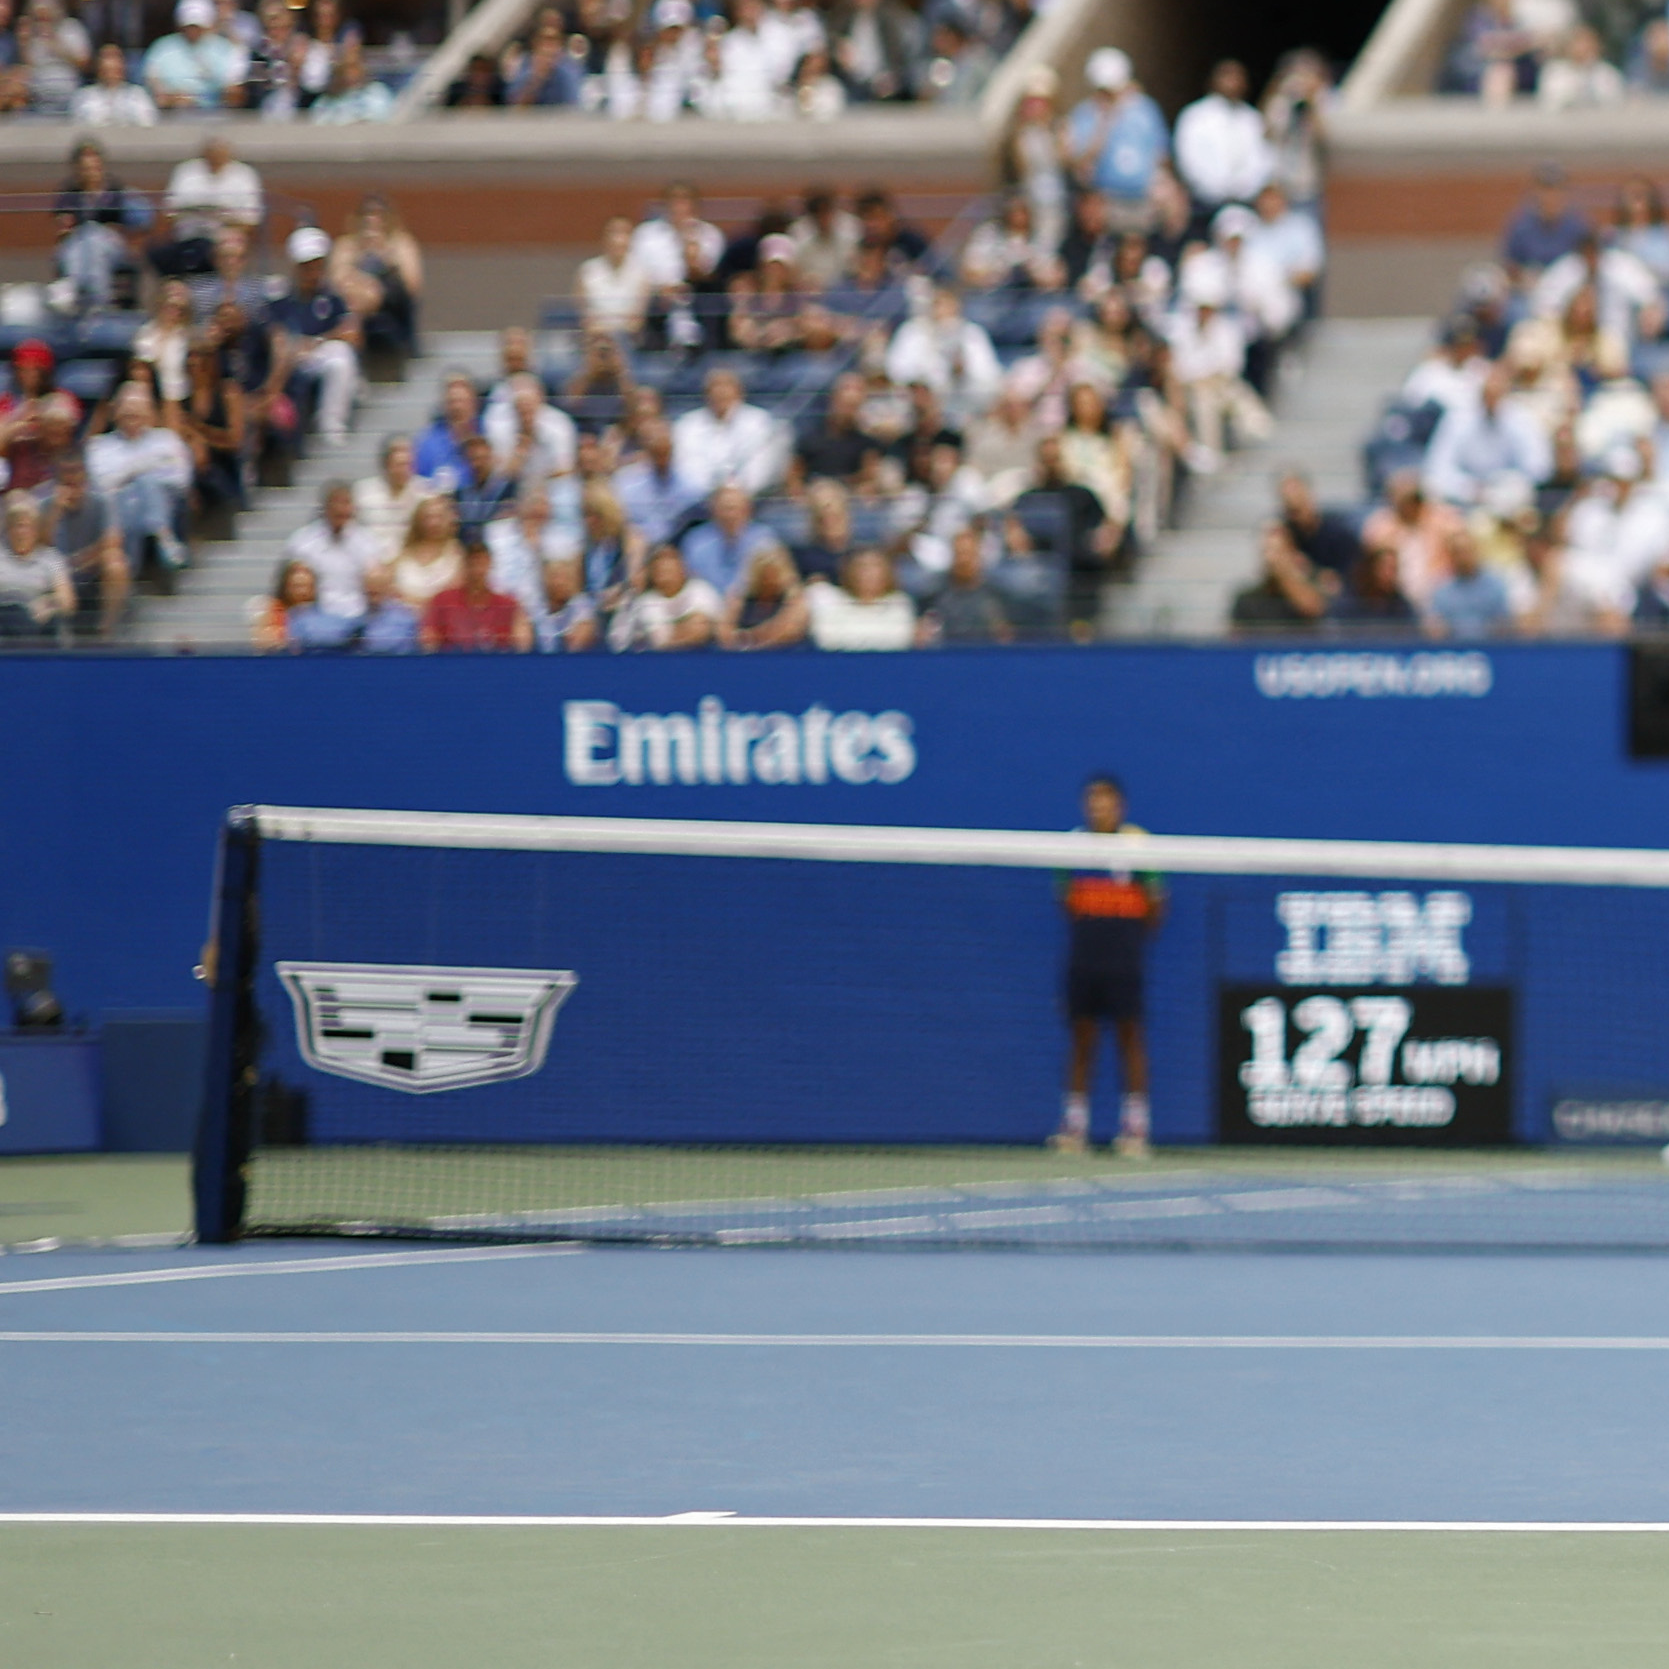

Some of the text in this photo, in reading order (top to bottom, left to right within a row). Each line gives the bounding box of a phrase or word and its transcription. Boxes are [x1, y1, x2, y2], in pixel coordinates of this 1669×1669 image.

[1254, 651, 1493, 699] USOPEN.ORG
[562, 694, 916, 785] Emirates
[1275, 890, 1472, 987] IBM
[1238, 995, 1413, 1091] 127
